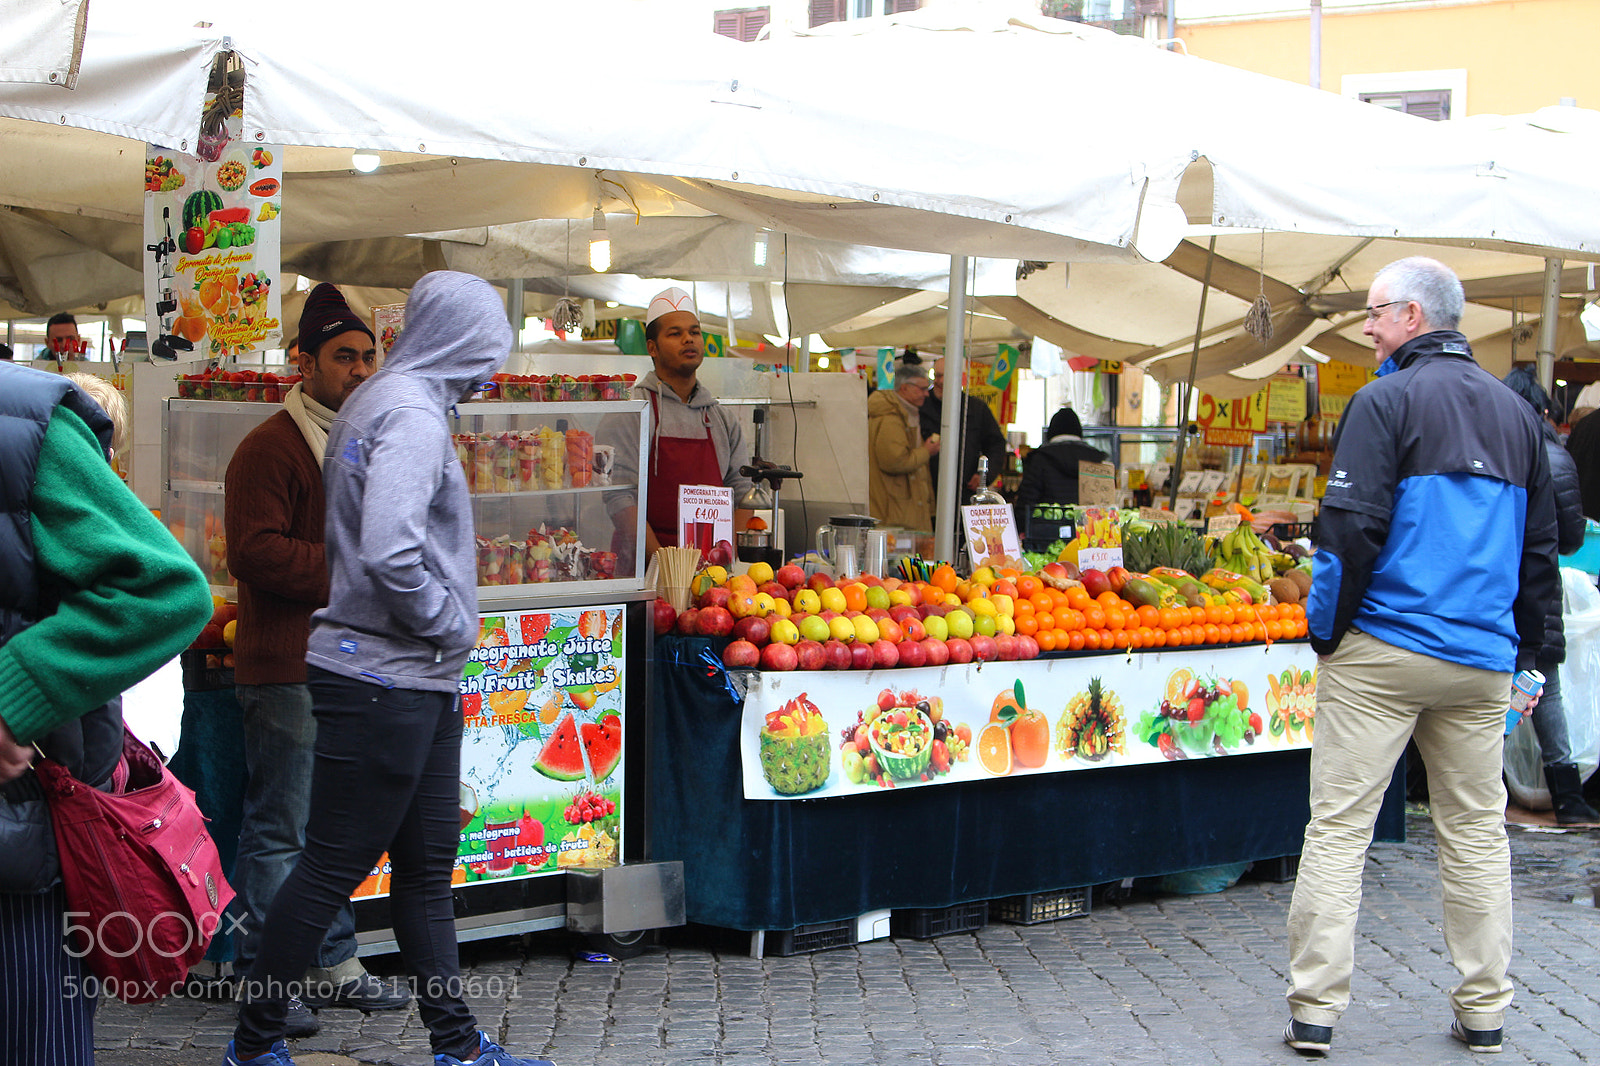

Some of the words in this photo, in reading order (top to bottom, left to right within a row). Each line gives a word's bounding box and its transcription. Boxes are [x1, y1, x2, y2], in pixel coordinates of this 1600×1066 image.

[175, 254, 213, 274] Spremuta
[213, 253, 223, 264] di
[220, 250, 253, 266] Arancia
[195, 267, 222, 283] Orange
[219, 266, 240, 283] juice
[210, 324, 249, 339] Macedonia
[255, 317, 279, 332] Frutta
[224, 335, 245, 350] Fruit
[243, 330, 268, 347] Salad
[683, 488, 717, 497] POMEGRANATE
[683, 497, 697, 505] SUCCO
[704, 498, 729, 506] MELOGRANO
[695, 507, 719, 521] €4,00
[970, 508, 992, 517] ORANGE
[562, 635, 613, 656] Juice
[484, 670, 536, 694] Fruit
[552, 665, 616, 688] Shakes
[464, 715, 488, 728] TTA
[491, 711, 537, 726] FRESCA
[469, 825, 521, 842] melograno
[503, 843, 543, 860] batidos
[545, 841, 558, 853] de
[560, 837, 589, 852] fruta
